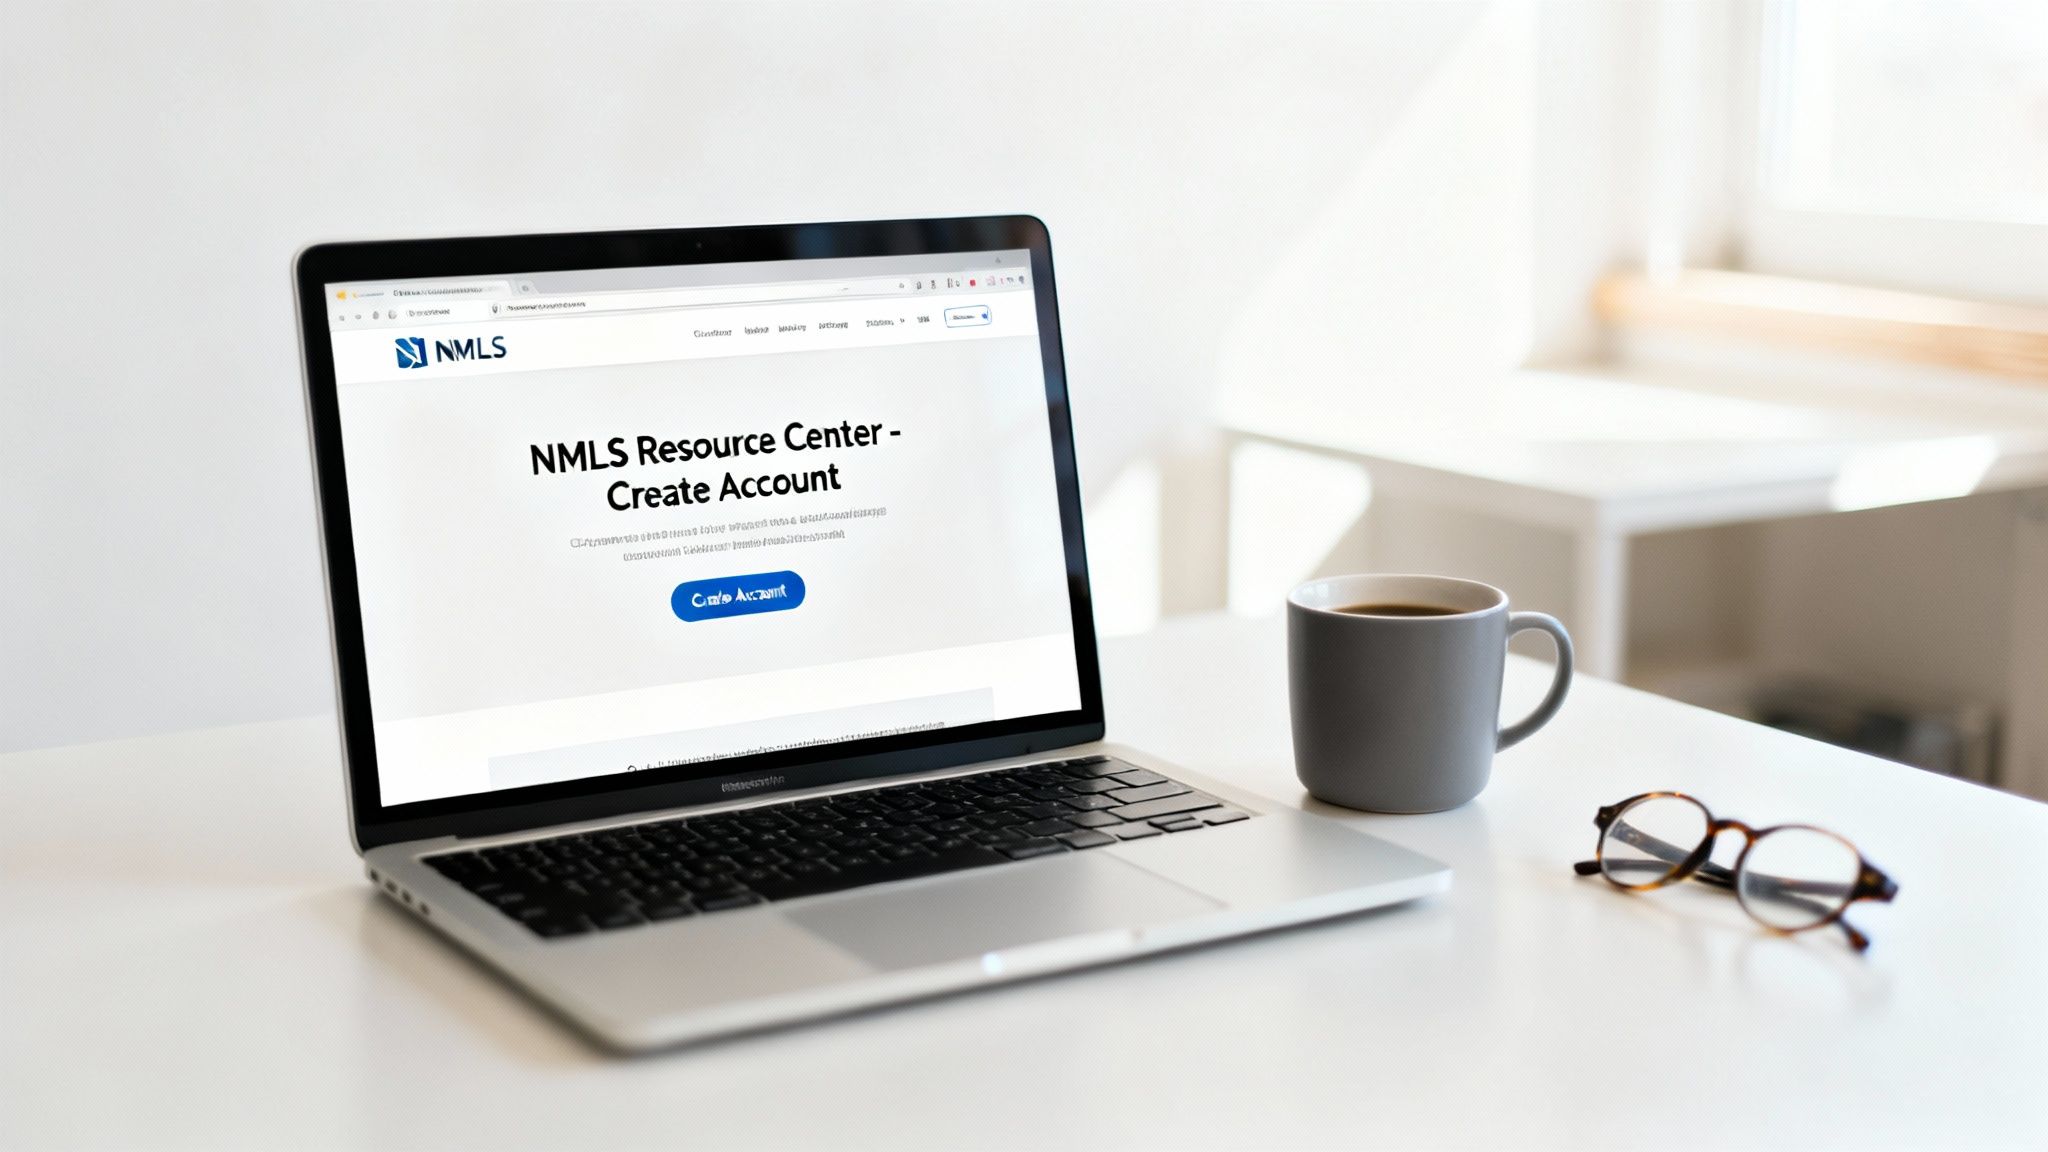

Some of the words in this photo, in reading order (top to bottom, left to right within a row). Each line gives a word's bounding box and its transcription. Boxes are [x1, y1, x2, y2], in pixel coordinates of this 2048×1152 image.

[436, 335, 507, 363] NMLS
[530, 437, 629, 475] NMLS
[637, 432, 777, 466] Resource
[784, 421, 883, 451] Center
[606, 478, 711, 511] Create
[719, 463, 842, 502] Account
